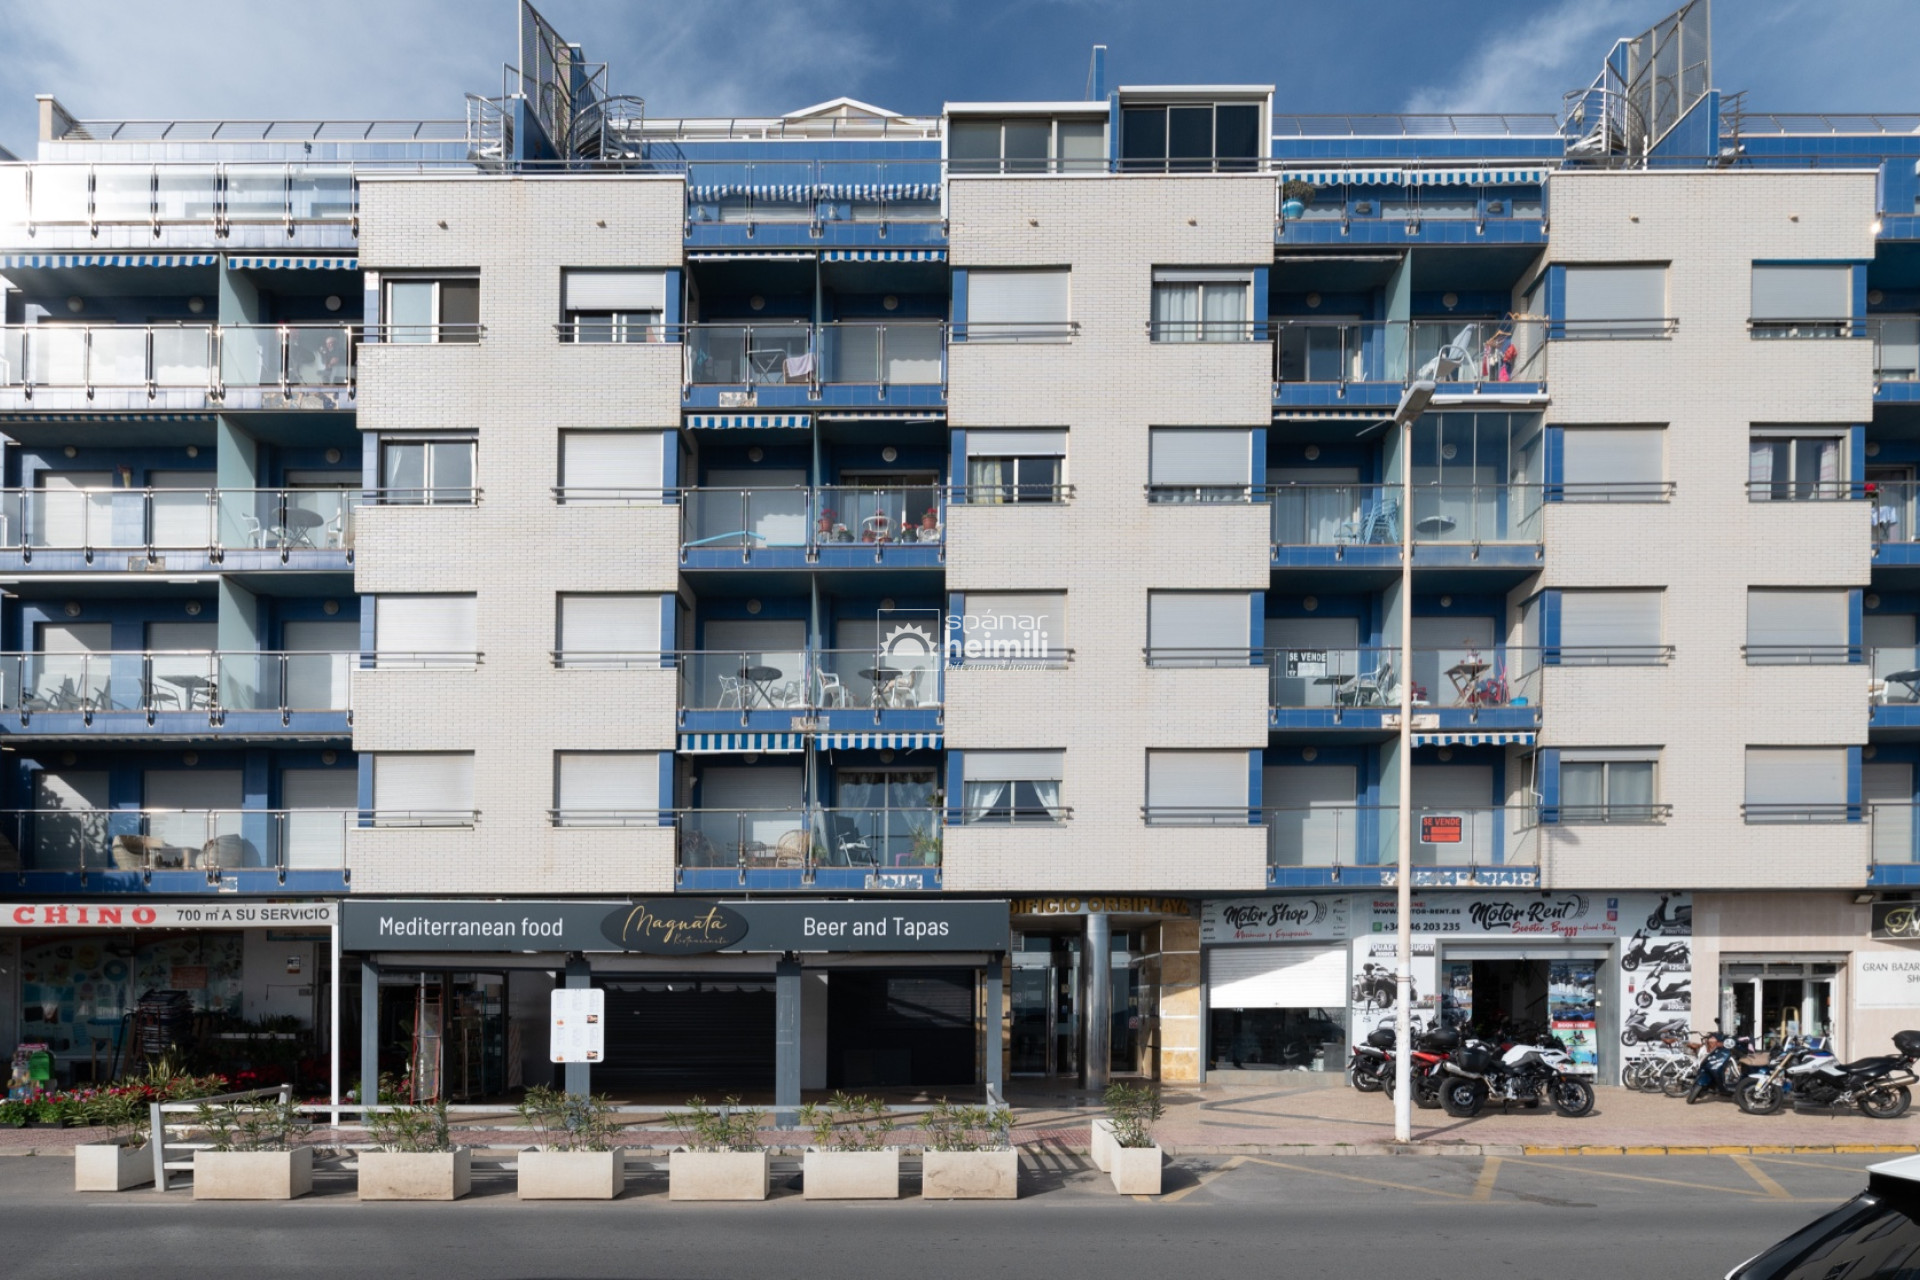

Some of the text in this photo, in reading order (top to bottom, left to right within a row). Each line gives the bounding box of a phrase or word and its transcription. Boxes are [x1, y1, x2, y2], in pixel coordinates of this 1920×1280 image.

[1289, 652, 1326, 662] SE VENDE
[1423, 818, 1460, 826] SE VENDE
[1010, 897, 1189, 914] DIFICIO ORBIPLAYA
[13, 906, 157, 925] CHINO
[177, 910, 201, 921] 700
[222, 909, 232, 921] A
[236, 909, 256, 921] SU
[260, 908, 330, 921] SERVICIO
[622, 905, 728, 944] Magnata
[1223, 902, 1309, 929] Motor Shop
[1468, 901, 1575, 931] Motor Rent
[379, 916, 563, 936] Mediterranean food
[804, 917, 949, 940] Beer and Tapas
[1423, 923, 1440, 931] 203
[1443, 923, 1460, 931] 235
[1862, 962, 1920, 972] GRAN BAZAR
